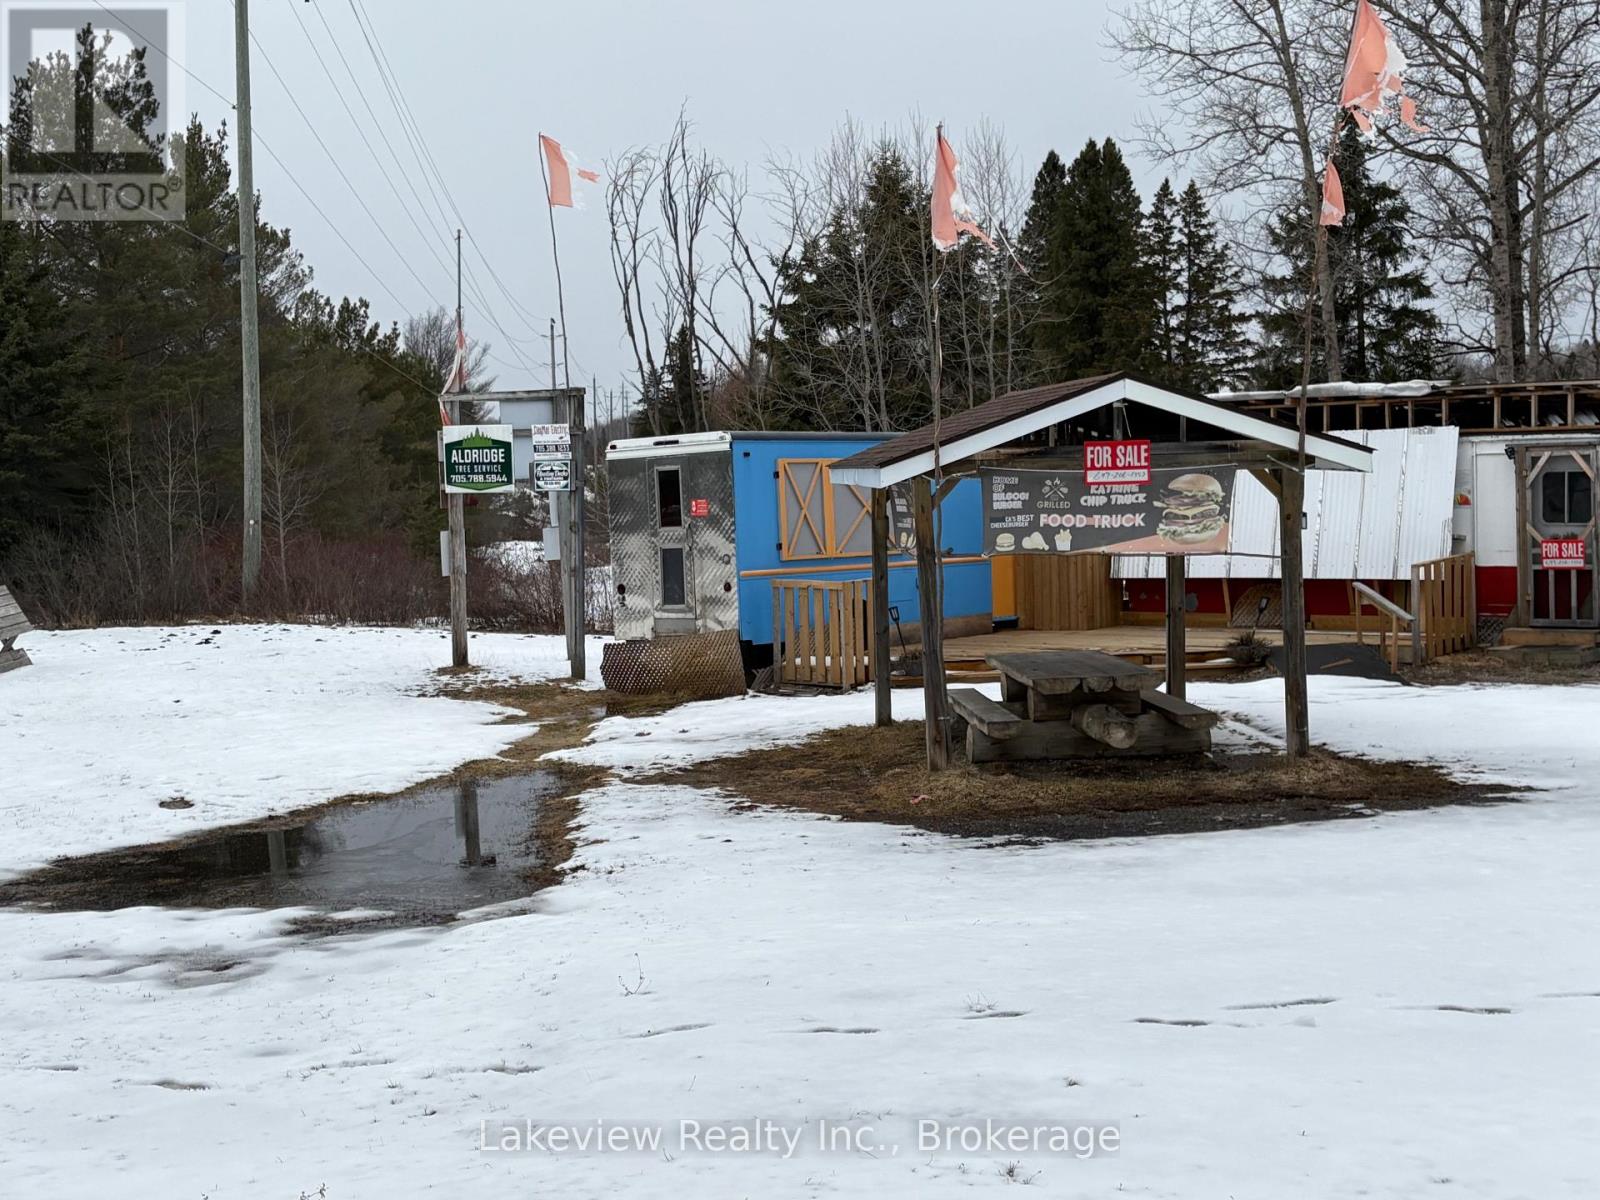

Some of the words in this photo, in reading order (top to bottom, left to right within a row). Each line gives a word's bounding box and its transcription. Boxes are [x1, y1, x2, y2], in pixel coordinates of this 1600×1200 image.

[451, 448, 506, 463] ALDRIDGE
[1086, 446, 1112, 468] FOR
[1116, 445, 1148, 467] SALE
[455, 465, 471, 473] TREE
[474, 464, 502, 473] SERVICE
[450, 474, 508, 483] 705.788.5944
[992, 492, 1030, 501] BULGOGI
[1080, 496, 1108, 507] CHIP
[1110, 493, 1147, 505] TRUCK
[992, 501, 1023, 510] BURGER
[1037, 501, 1071, 509] GRILLED
[1017, 514, 1035, 522] BEST
[1040, 514, 1087, 528] FOOD
[1093, 513, 1146, 528] TRUCK
[1542, 543, 1559, 557] FOR
[1562, 542, 1584, 557] SALE
